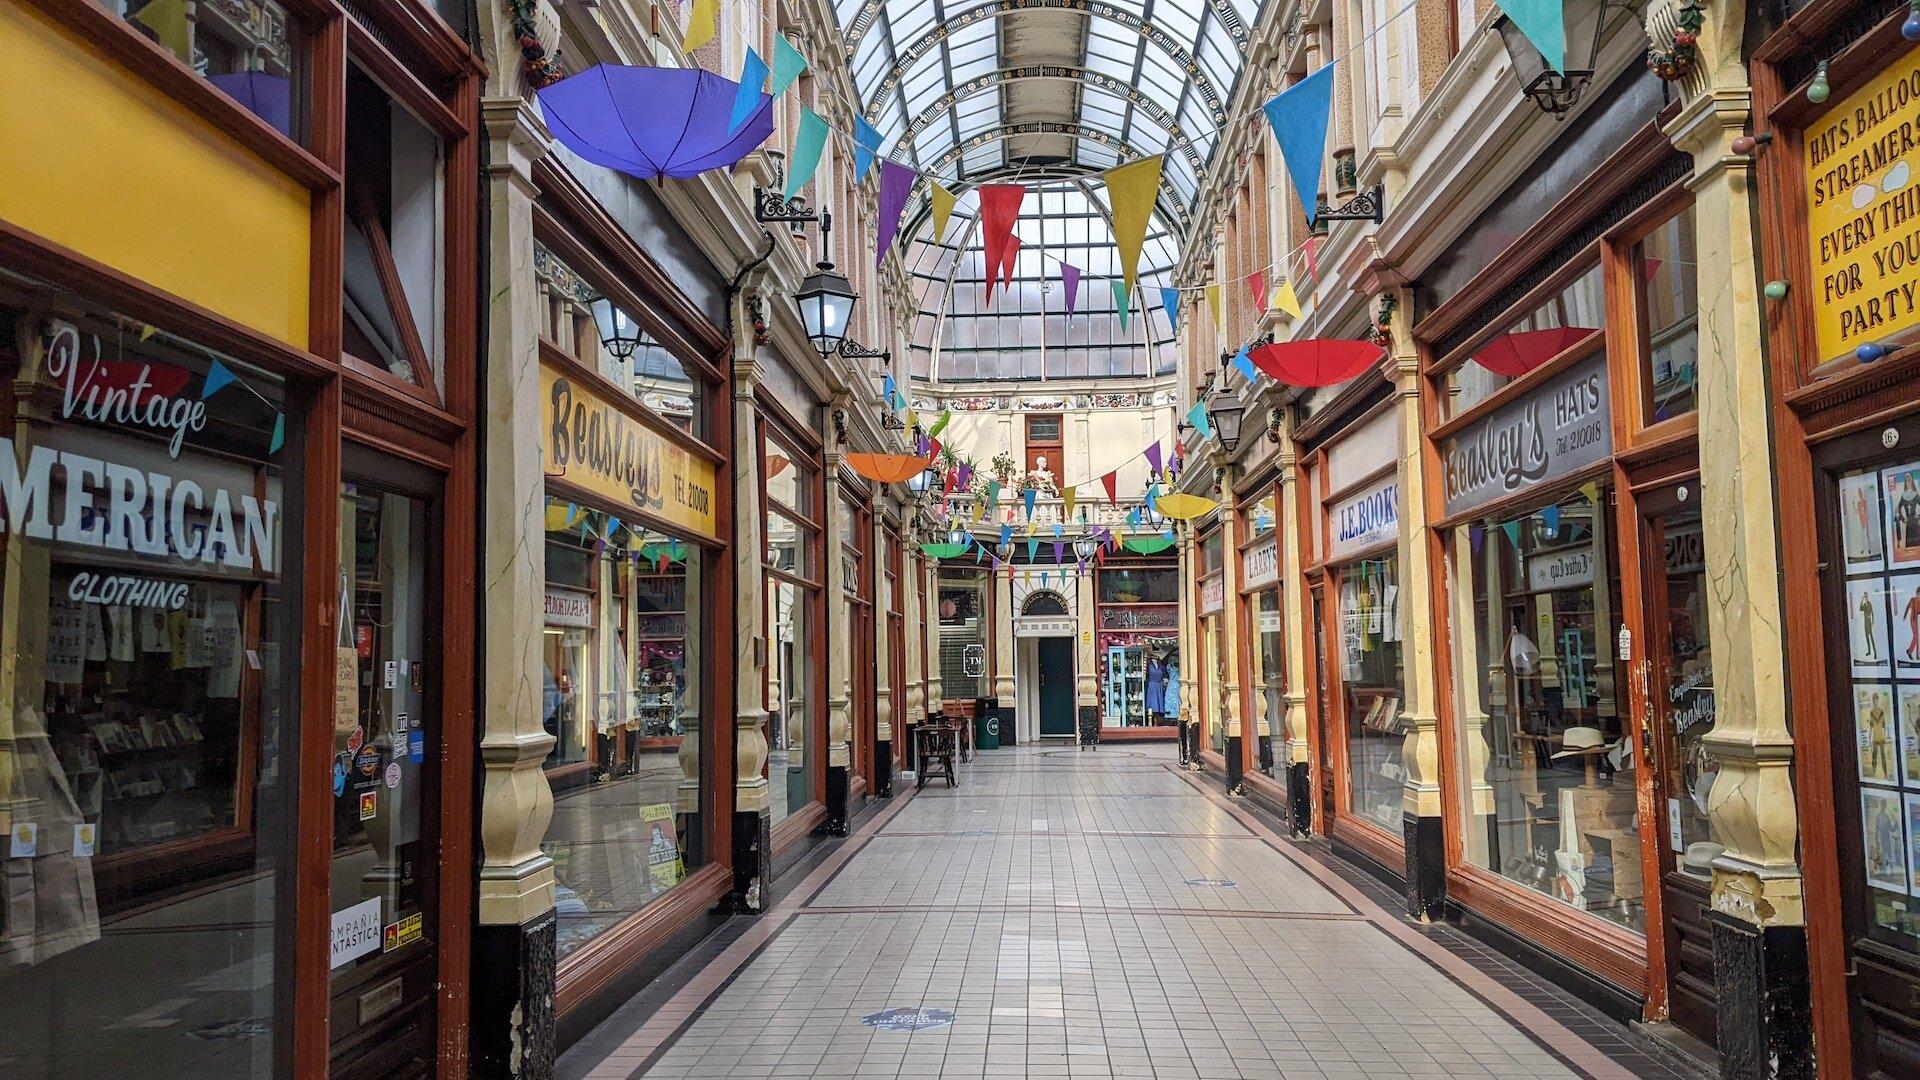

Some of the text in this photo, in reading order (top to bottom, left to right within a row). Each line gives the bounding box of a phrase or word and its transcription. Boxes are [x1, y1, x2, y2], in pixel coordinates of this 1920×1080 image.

[1824, 262, 1863, 305] FOR
[1840, 279, 1917, 341] PARTY
[48, 327, 207, 459] Vintage
[1554, 374, 1599, 431] HATS
[1444, 400, 1549, 504] Beasley's
[1569, 420, 1601, 451] 210018
[688, 481, 709, 516] 210018
[68, 572, 189, 610] CLOTHING
